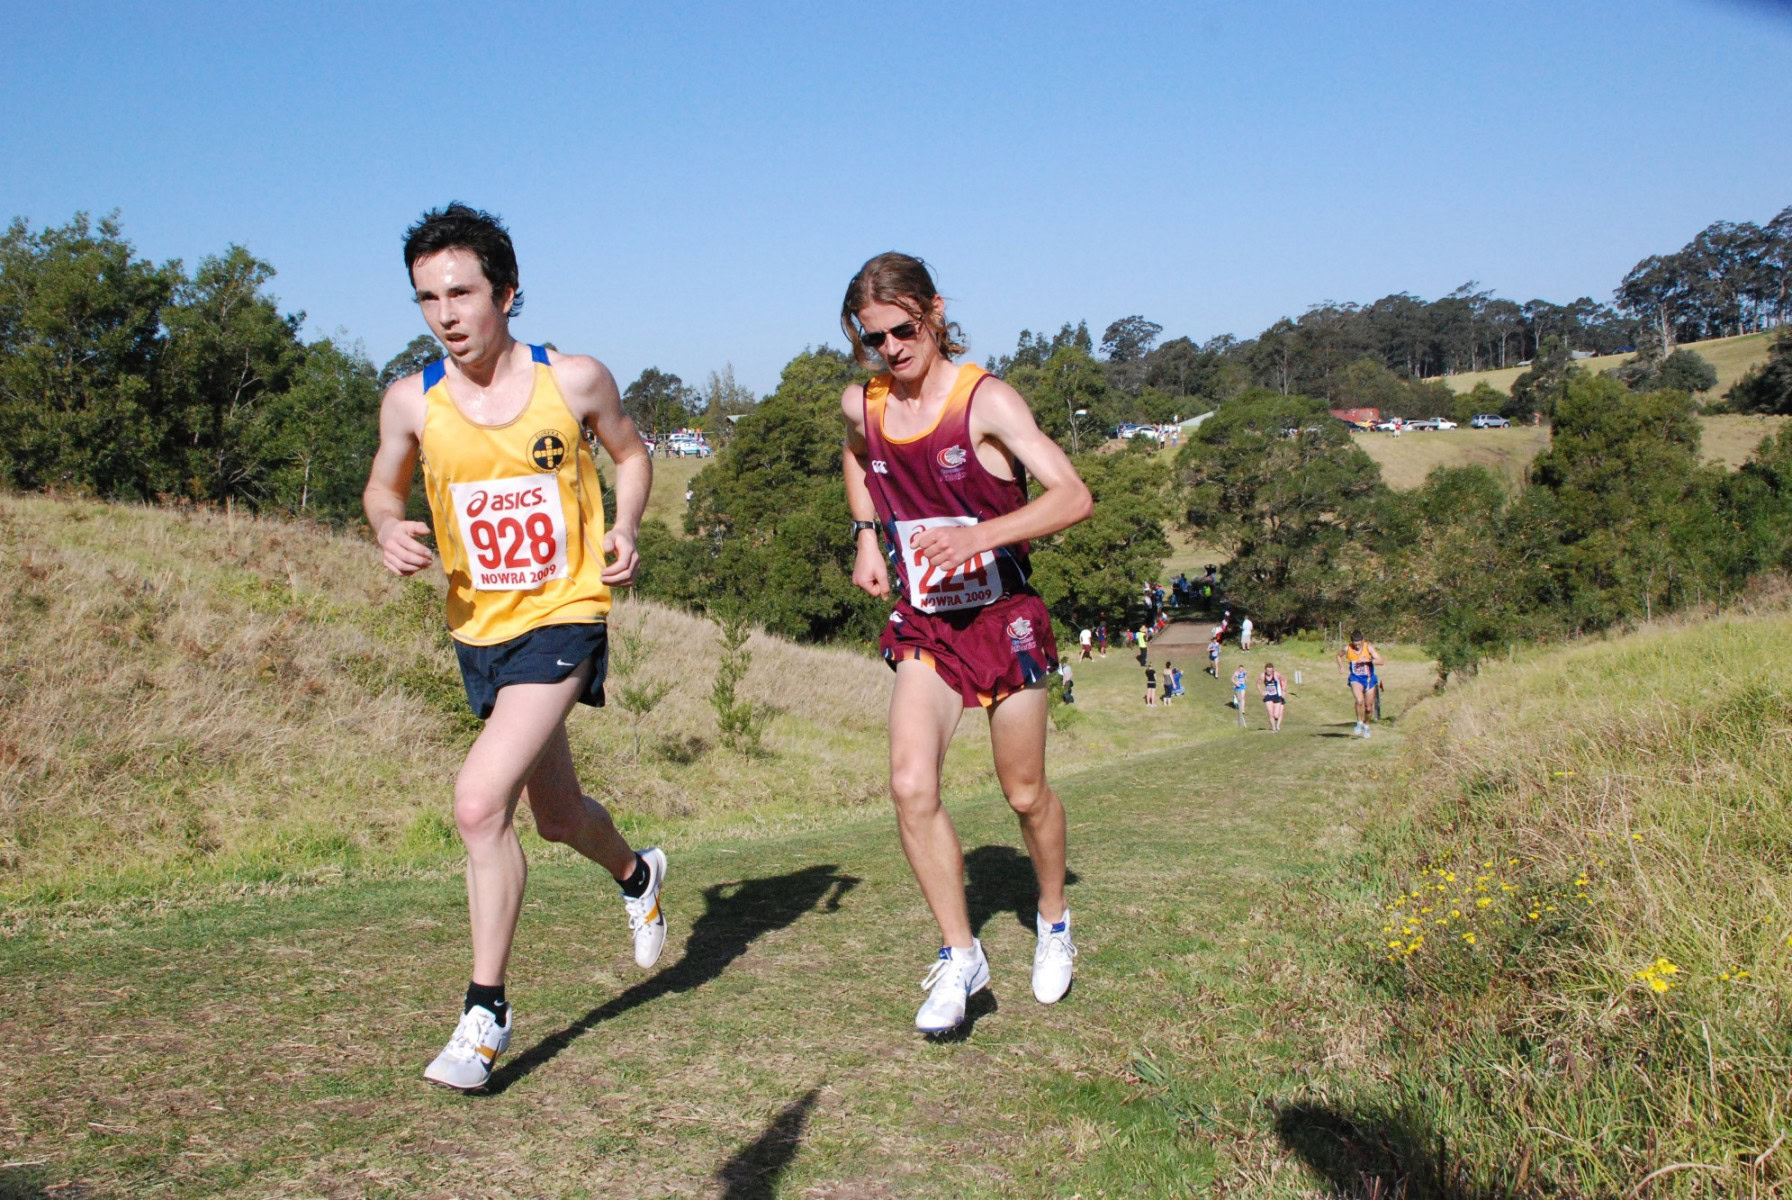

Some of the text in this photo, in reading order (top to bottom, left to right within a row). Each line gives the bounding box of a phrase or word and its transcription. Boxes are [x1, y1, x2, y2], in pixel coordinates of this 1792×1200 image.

[470, 512, 557, 570] 928
[481, 564, 557, 585] NOWRA 2009
[921, 589, 992, 608] NOWRA 2009
